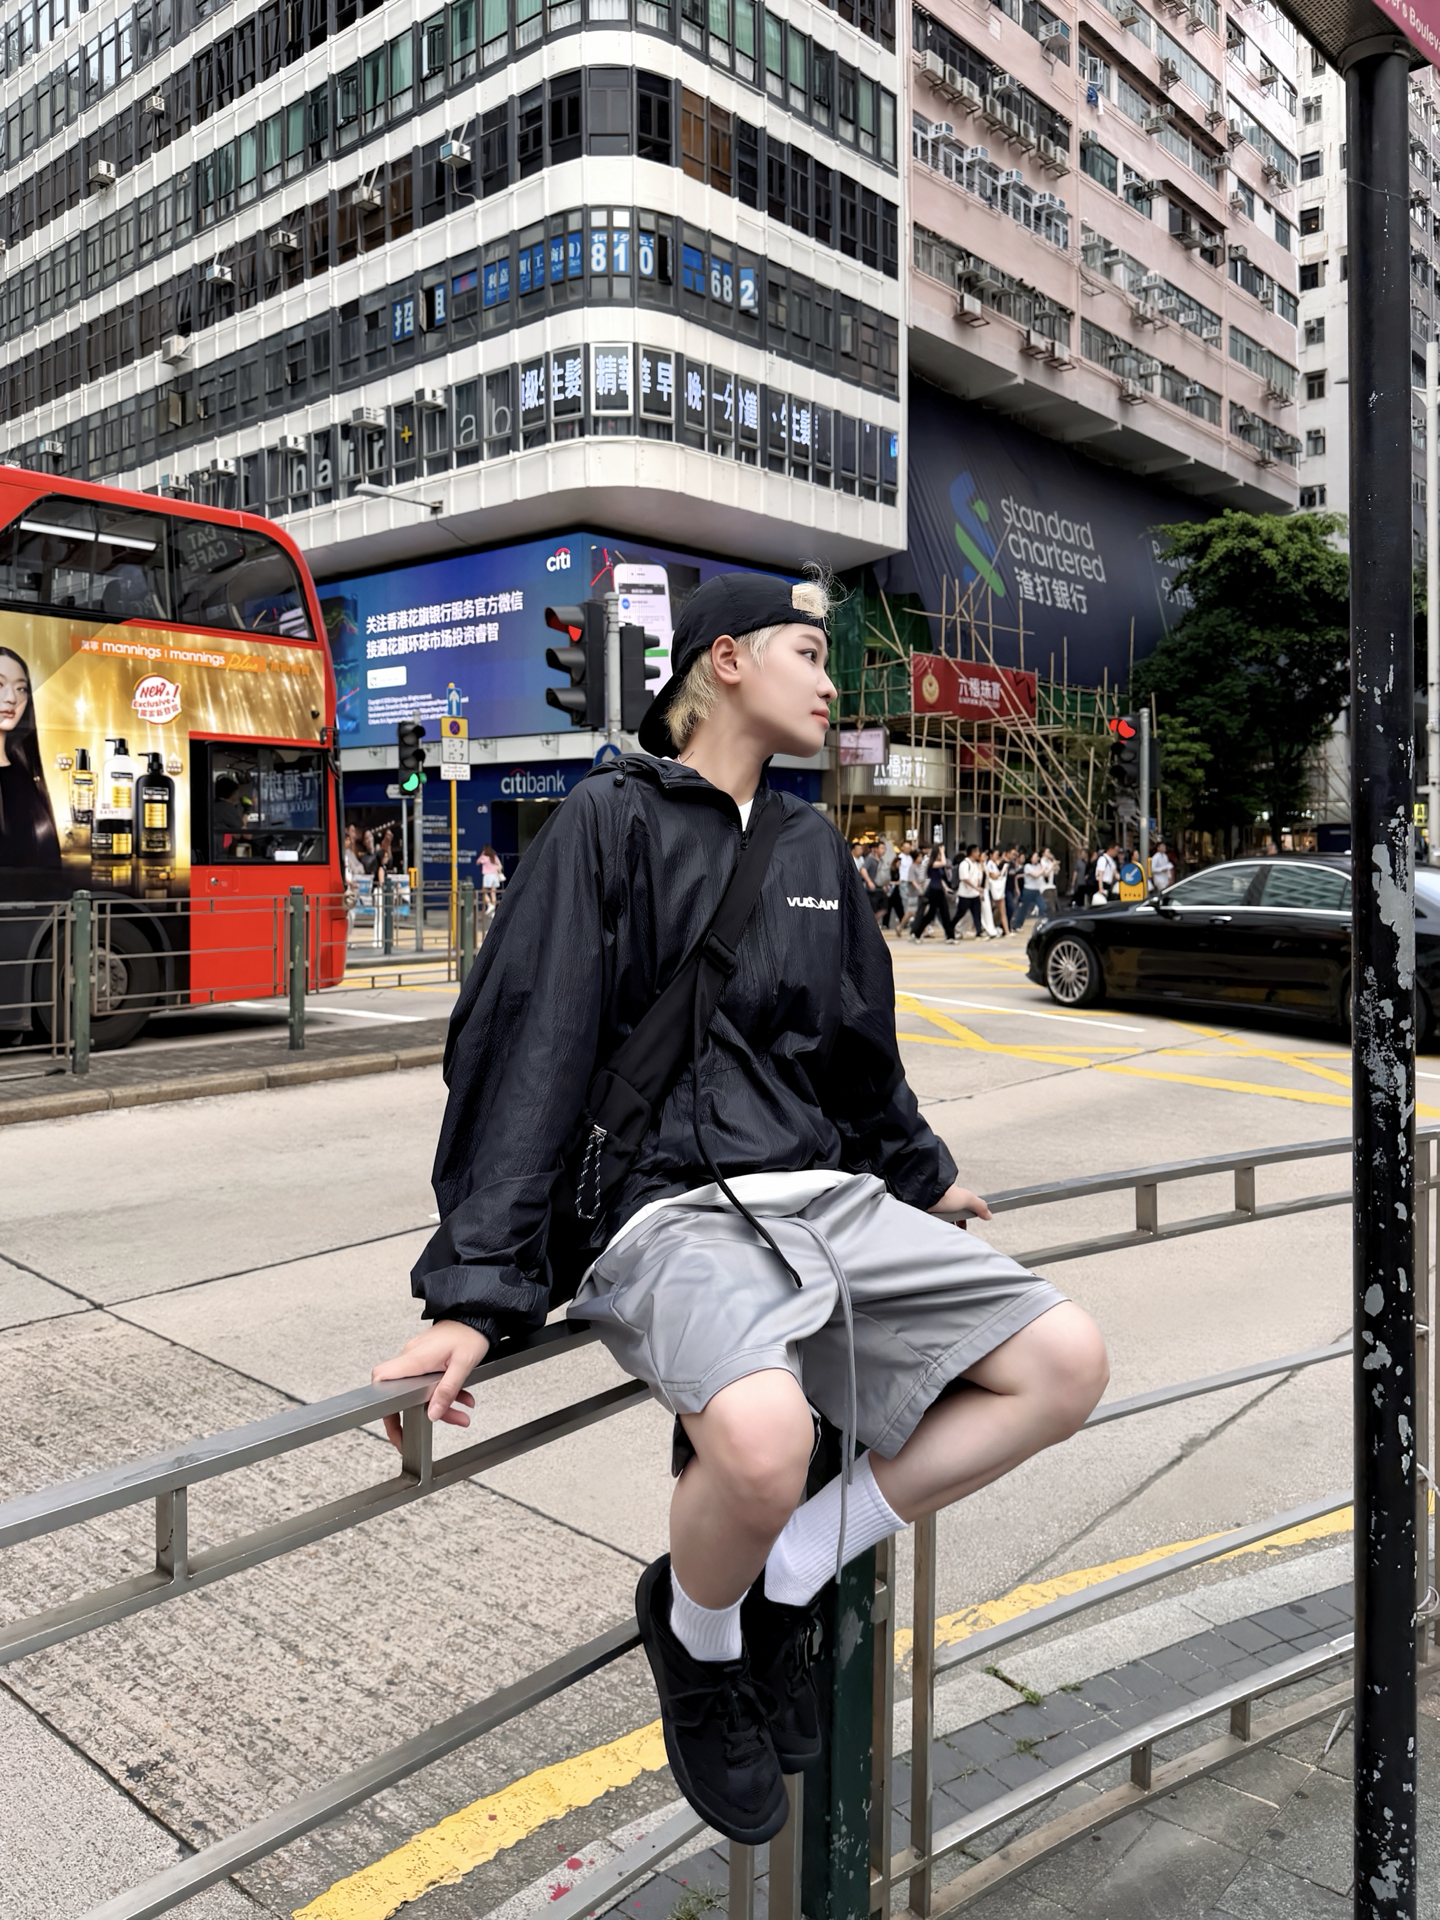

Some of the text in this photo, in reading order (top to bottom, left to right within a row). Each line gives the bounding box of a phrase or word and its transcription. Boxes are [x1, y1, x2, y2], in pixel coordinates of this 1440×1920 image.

[1001, 495, 1095, 551] standard
[547, 550, 570, 572] citi
[1008, 530, 1107, 583] chartered
[1014, 566, 1087, 614] 渣打銀行
[102, 640, 162, 659] mannings
[170, 649, 226, 667] mannings
[501, 769, 566, 794] citibank
